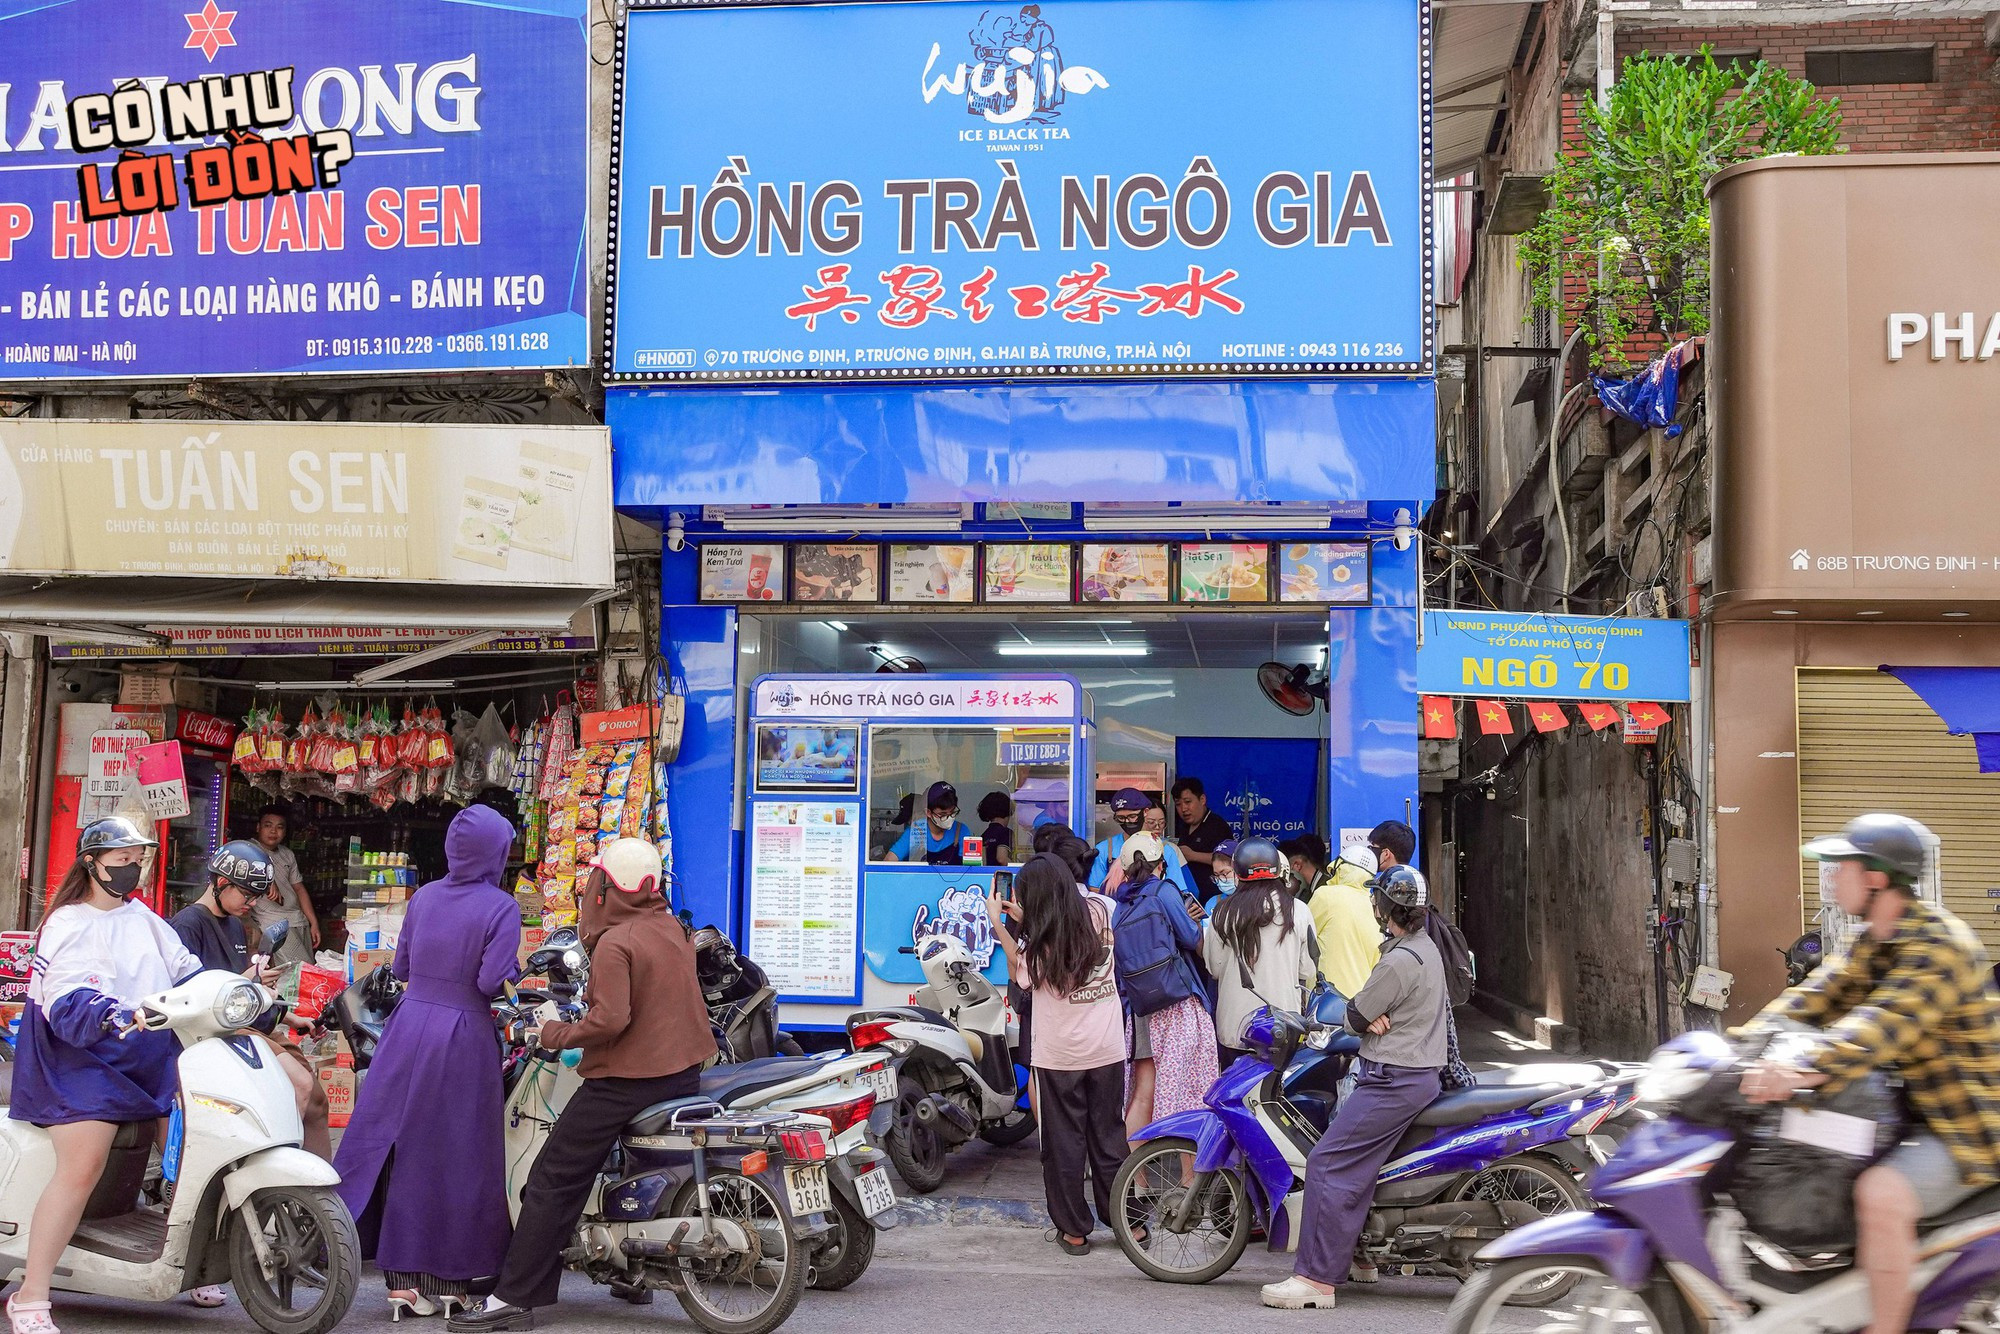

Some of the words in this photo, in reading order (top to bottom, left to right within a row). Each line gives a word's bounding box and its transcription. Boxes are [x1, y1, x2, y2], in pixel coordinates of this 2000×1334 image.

[256, 53, 482, 141] ONG
[959, 129, 983, 141] ICE
[988, 128, 1038, 140] BLACK
[1043, 127, 1070, 140] TEA
[986, 144, 1020, 152] TAIWAN
[1024, 143, 1044, 152] 1951
[647, 154, 863, 258] HỒNG
[883, 157, 1039, 254] TRÀ
[1059, 156, 1229, 252] NGÔ
[1254, 170, 1393, 250] GIA
[365, 184, 481, 250] SEN
[21, 283, 71, 320] BÁN
[81, 281, 109, 318] LẺ
[118, 281, 170, 317] CÁC
[180, 285, 237, 322] LOẠI
[247, 277, 317, 314] HÀNG
[327, 274, 380, 312] KHÔ
[411, 271, 483, 309] BÁNH
[493, 274, 545, 312] KẸO
[5, 342, 50, 363] HOÀNG
[53, 345, 78, 362] MAI
[91, 340, 111, 362] HÀ
[114, 340, 137, 364] NỘI
[306, 339, 329, 357] ĐT:
[332, 336, 433, 356] 0915.310.228
[446, 332, 549, 352] 0366.191.628
[720, 350, 738, 364] 70
[742, 348, 804, 364] TRƯƠNG
[808, 349, 850, 366] ĐỊNH,
[855, 347, 930, 363] P.TRƯƠNG
[933, 347, 976, 365] ĐỊNH,
[980, 345, 1025, 360] Q.HAI
[1029, 342, 1050, 359] BÀ
[1055, 344, 1111, 361] TRƯNG,
[1115, 341, 1158, 359] TP.HÀ
[1162, 341, 1191, 361] NỘI
[1222, 343, 1286, 358] HOTLINE
[1299, 343, 1337, 356] 0943
[1342, 343, 1370, 356] 116
[1374, 342, 1404, 356] 236
[637, 352, 692, 365] #HN001
[20, 443, 48, 462] CỬA
[54, 445, 93, 463] HÀNG
[100, 432, 258, 511] TUẤN
[288, 449, 409, 514] SEN
[105, 517, 159, 534] CHUYÊN:
[164, 518, 190, 533] BÁN
[195, 518, 219, 534] CÁC
[224, 521, 252, 537] LOẠI
[258, 521, 281, 538] BỘT
[287, 523, 320, 538] THỰC
[325, 518, 362, 537] PHẨM
[169, 538, 192, 554] BÁN
[238, 540, 261, 555] BÁN
[322, 543, 347, 556] KHÔ
[707, 547, 727, 558] Hồng
[730, 548, 742, 556] Trà
[1314, 550, 1343, 559] Pudding
[120, 561, 129, 570] 72
[707, 558, 724, 566] Kem
[726, 557, 743, 566] Tươi
[1817, 556, 1848, 570] 68B
[1852, 555, 1930, 570] TRƯƠNG
[1935, 556, 1976, 573] ĐỊNH
[188, 629, 212, 641] HỢP
[255, 629, 271, 638] DU
[279, 628, 303, 640] LỊCH
[1448, 620, 1486, 631] UBND
[1551, 624, 1607, 636] TRƯƠNG
[1610, 627, 1643, 638] ĐỊNH
[113, 647, 124, 656] 72
[397, 643, 420, 652] 0973
[498, 641, 521, 650] 0913
[524, 640, 536, 650] 58
[553, 640, 565, 649] 88
[1509, 636, 1540, 648] DÂN
[1543, 635, 1571, 650] PHỐ
[1574, 637, 1593, 650] SỐ
[1597, 642, 1604, 650] 8
[1462, 654, 1558, 688] NGÕ
[1573, 661, 1630, 691] 70
[810, 691, 853, 706] HỒNG
[857, 691, 885, 706] TRÀ
[891, 691, 925, 706] NGÔ
[929, 694, 955, 706] GIA
[92, 737, 105, 753] CHO
[108, 734, 123, 753] THUÊ
[104, 781, 118, 792] 0973
[1254, 820, 1281, 831] NGÔ
[1284, 821, 1305, 831] GIA
[866, 1188, 893, 1214] 7395
